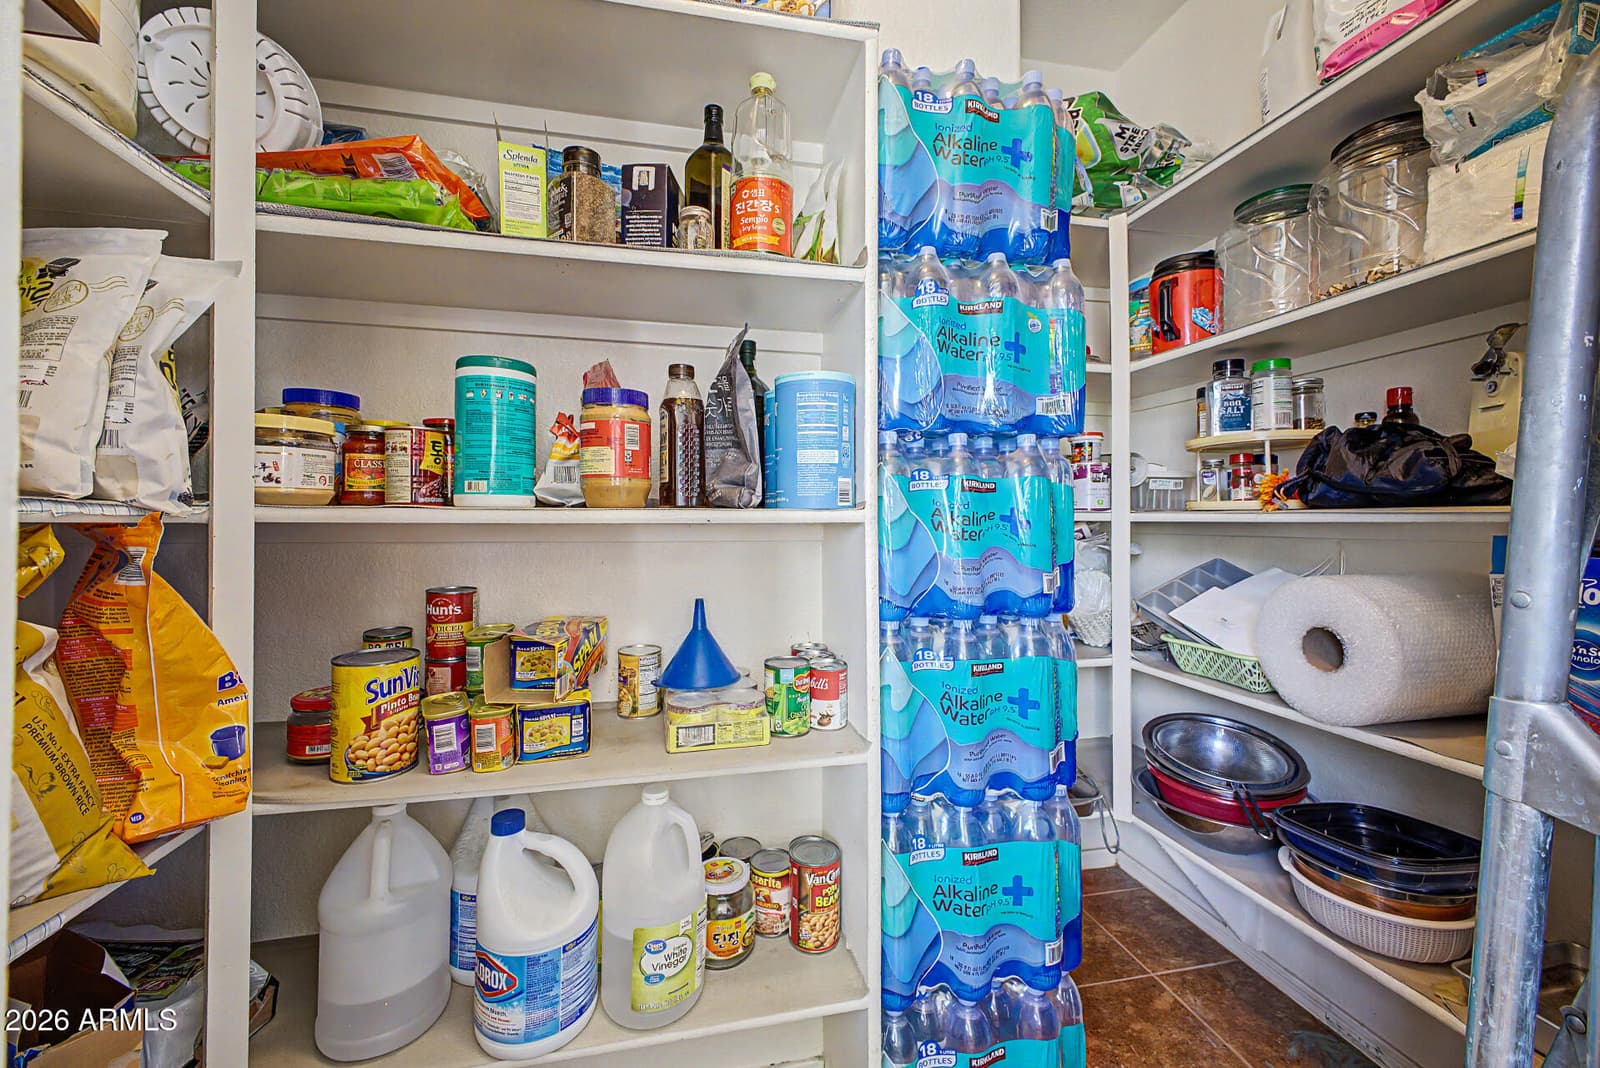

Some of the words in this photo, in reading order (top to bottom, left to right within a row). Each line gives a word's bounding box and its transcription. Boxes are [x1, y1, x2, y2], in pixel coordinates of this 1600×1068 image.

[915, 92, 933, 103] 18
[913, 102, 949, 112] BOTTLES
[935, 122, 973, 133] Ionized
[932, 132, 998, 153] Alkaline
[503, 149, 538, 163] Splenda
[932, 144, 985, 168] Water
[735, 199, 774, 215] 진간장
[917, 282, 936, 294] 18
[959, 301, 1003, 312] KIRKLAND
[936, 325, 1001, 347] Alkaline
[936, 338, 984, 361] Water
[1220, 406, 1245, 415] SALT
[912, 470, 930, 480] 18
[911, 480, 946, 490] BOTTLE
[931, 507, 996, 527] Akaline
[427, 603, 462, 616] Hunt's
[573, 622, 600, 677] SPAM
[916, 650, 934, 660] 18
[941, 681, 978, 695] Ionized
[381, 697, 407, 714] Pinto
[940, 690, 1003, 711] Alkaline
[939, 701, 990, 726] Water
[32, 715, 48, 734] U.S.
[79, 780, 96, 807] FANCY
[22, 723, 59, 765] PREMIUM
[55, 763, 78, 797] BROWN
[75, 796, 90, 817] RICE
[912, 837, 926, 850] 18
[934, 874, 973, 884] Ionized
[932, 883, 999, 902] Alkaline
[932, 899, 987, 918] Water
[664, 946, 688, 961] White
[652, 955, 687, 971] Vinegar
[919, 1043, 937, 1057] 18
[918, 1057, 953, 1068] BOTTLES
[971, 1048, 1005, 1068] KIRKLAND
